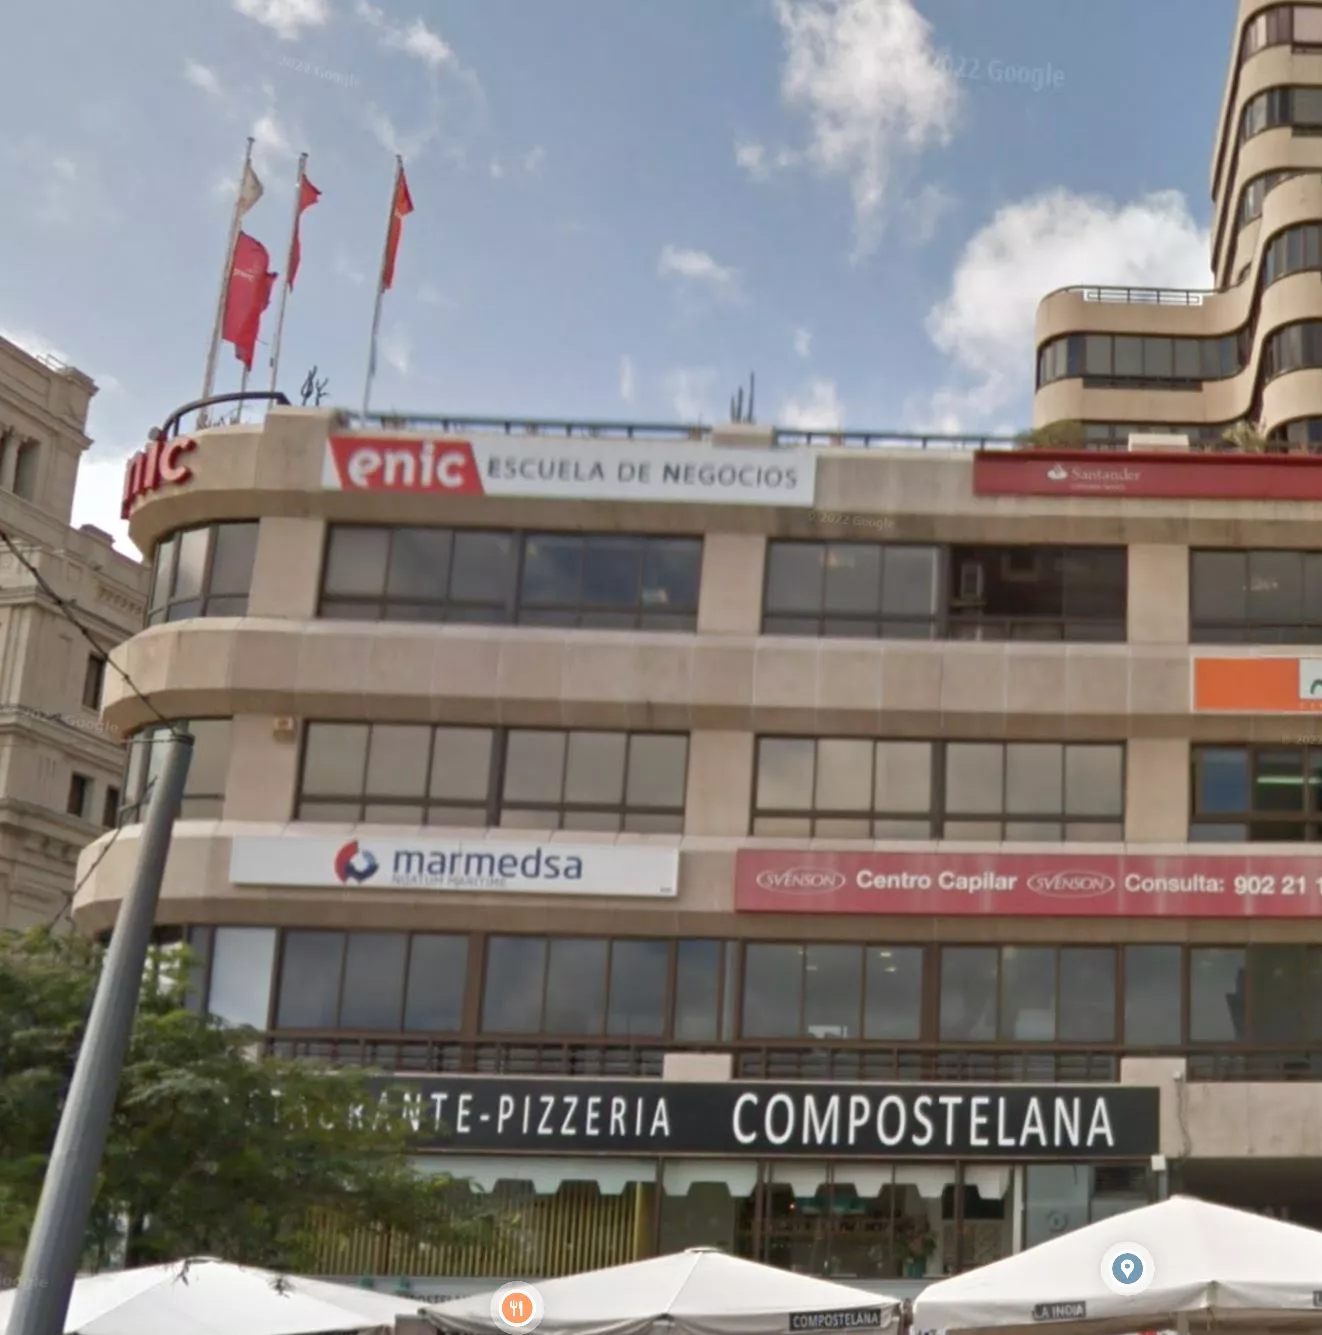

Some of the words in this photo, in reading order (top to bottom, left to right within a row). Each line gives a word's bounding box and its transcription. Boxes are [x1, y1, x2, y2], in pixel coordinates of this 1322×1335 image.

[121, 430, 196, 519] nic
[348, 441, 466, 487] enic
[487, 456, 605, 482] ESCUELA
[617, 459, 651, 484] DE
[662, 459, 799, 490] NEGOCIOS
[1071, 467, 1141, 481] Santander
[393, 846, 583, 880] marmedsa
[766, 871, 837, 889] SVENSON
[856, 869, 931, 890] Centro
[937, 869, 1017, 894] Capilar
[1037, 873, 1105, 891] SVENSON
[1124, 873, 1225, 893] Consulta:
[1233, 875, 1276, 895] 902
[1281, 876, 1306, 895] 21
[731, 1090, 1115, 1148] COMPOSTELANA
[792, 1311, 879, 1328] COMPOSTELANA
[1052, 1303, 1083, 1318] INDIA
